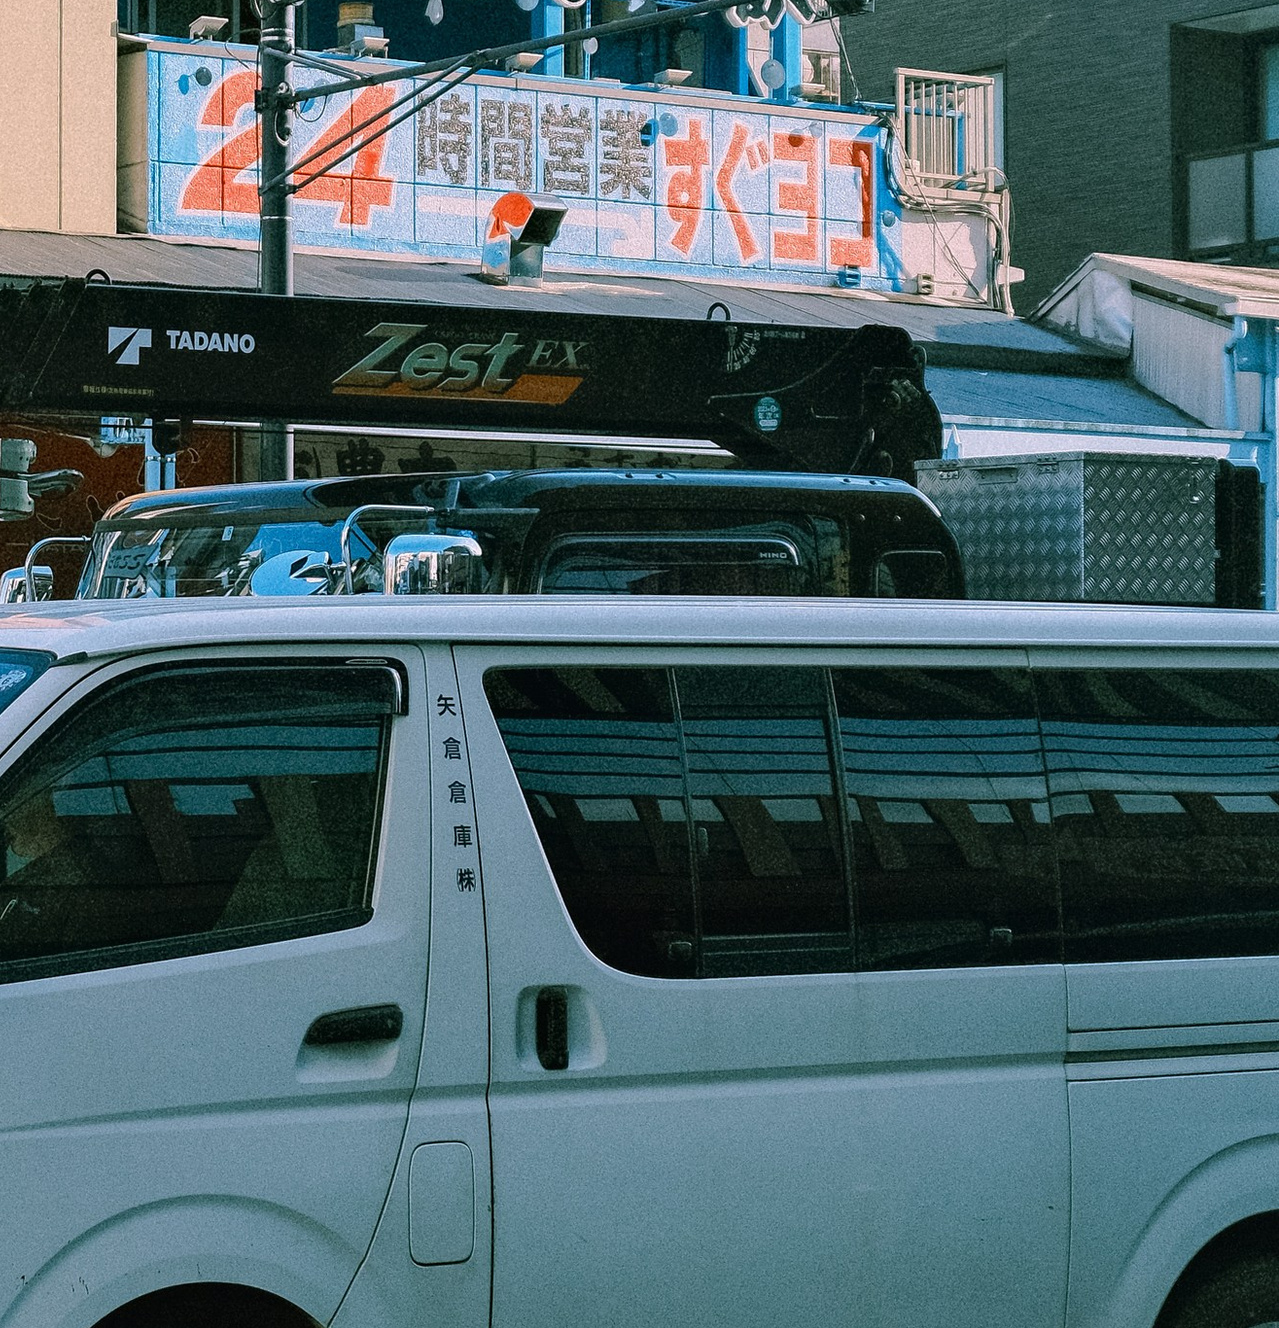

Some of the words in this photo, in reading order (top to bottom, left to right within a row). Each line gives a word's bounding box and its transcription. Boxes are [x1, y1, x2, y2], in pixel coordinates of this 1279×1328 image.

[166, 329, 255, 354] TADANO
[332, 321, 526, 389] Zest
[529, 339, 590, 370] EX
